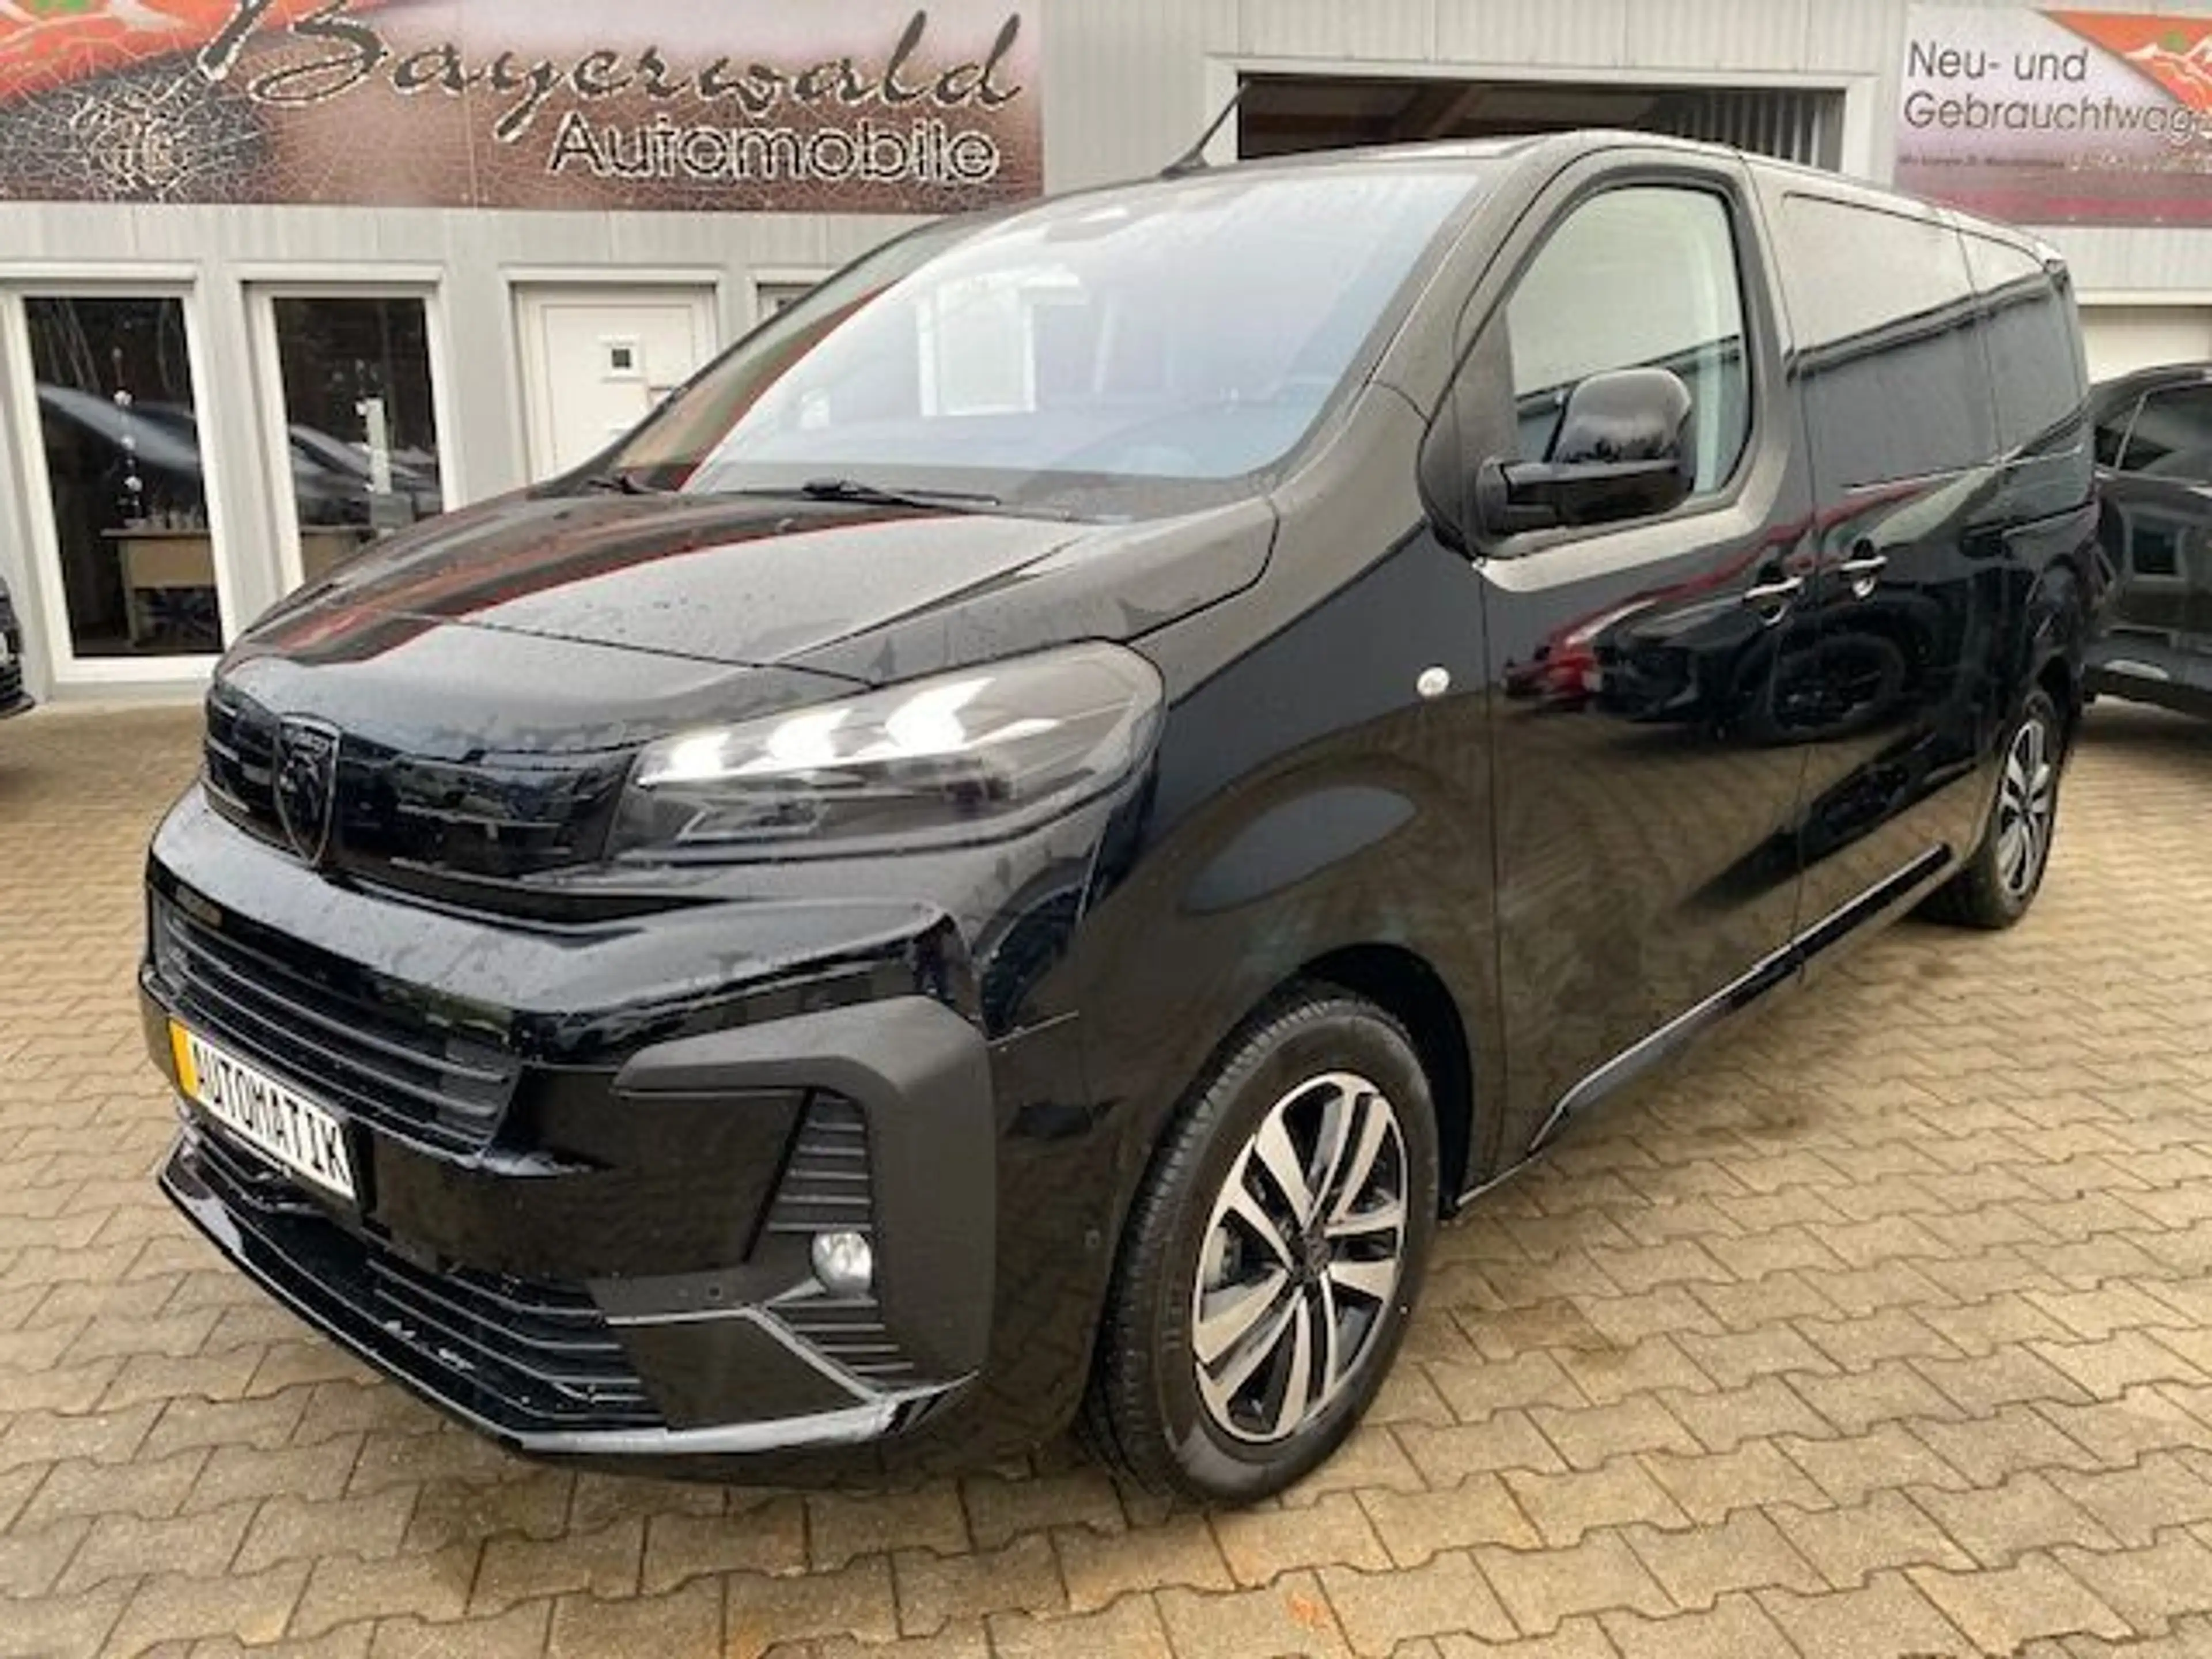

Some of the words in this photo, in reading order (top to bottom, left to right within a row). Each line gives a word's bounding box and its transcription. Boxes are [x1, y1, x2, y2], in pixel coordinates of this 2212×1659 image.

[198, 0, 1022, 142] Bayerwald
[1909, 41, 2001, 79] Neu-
[2014, 48, 2089, 82] und
[548, 111, 1001, 184] Automobile
[192, 1040, 350, 1188] AUTOMATIK
